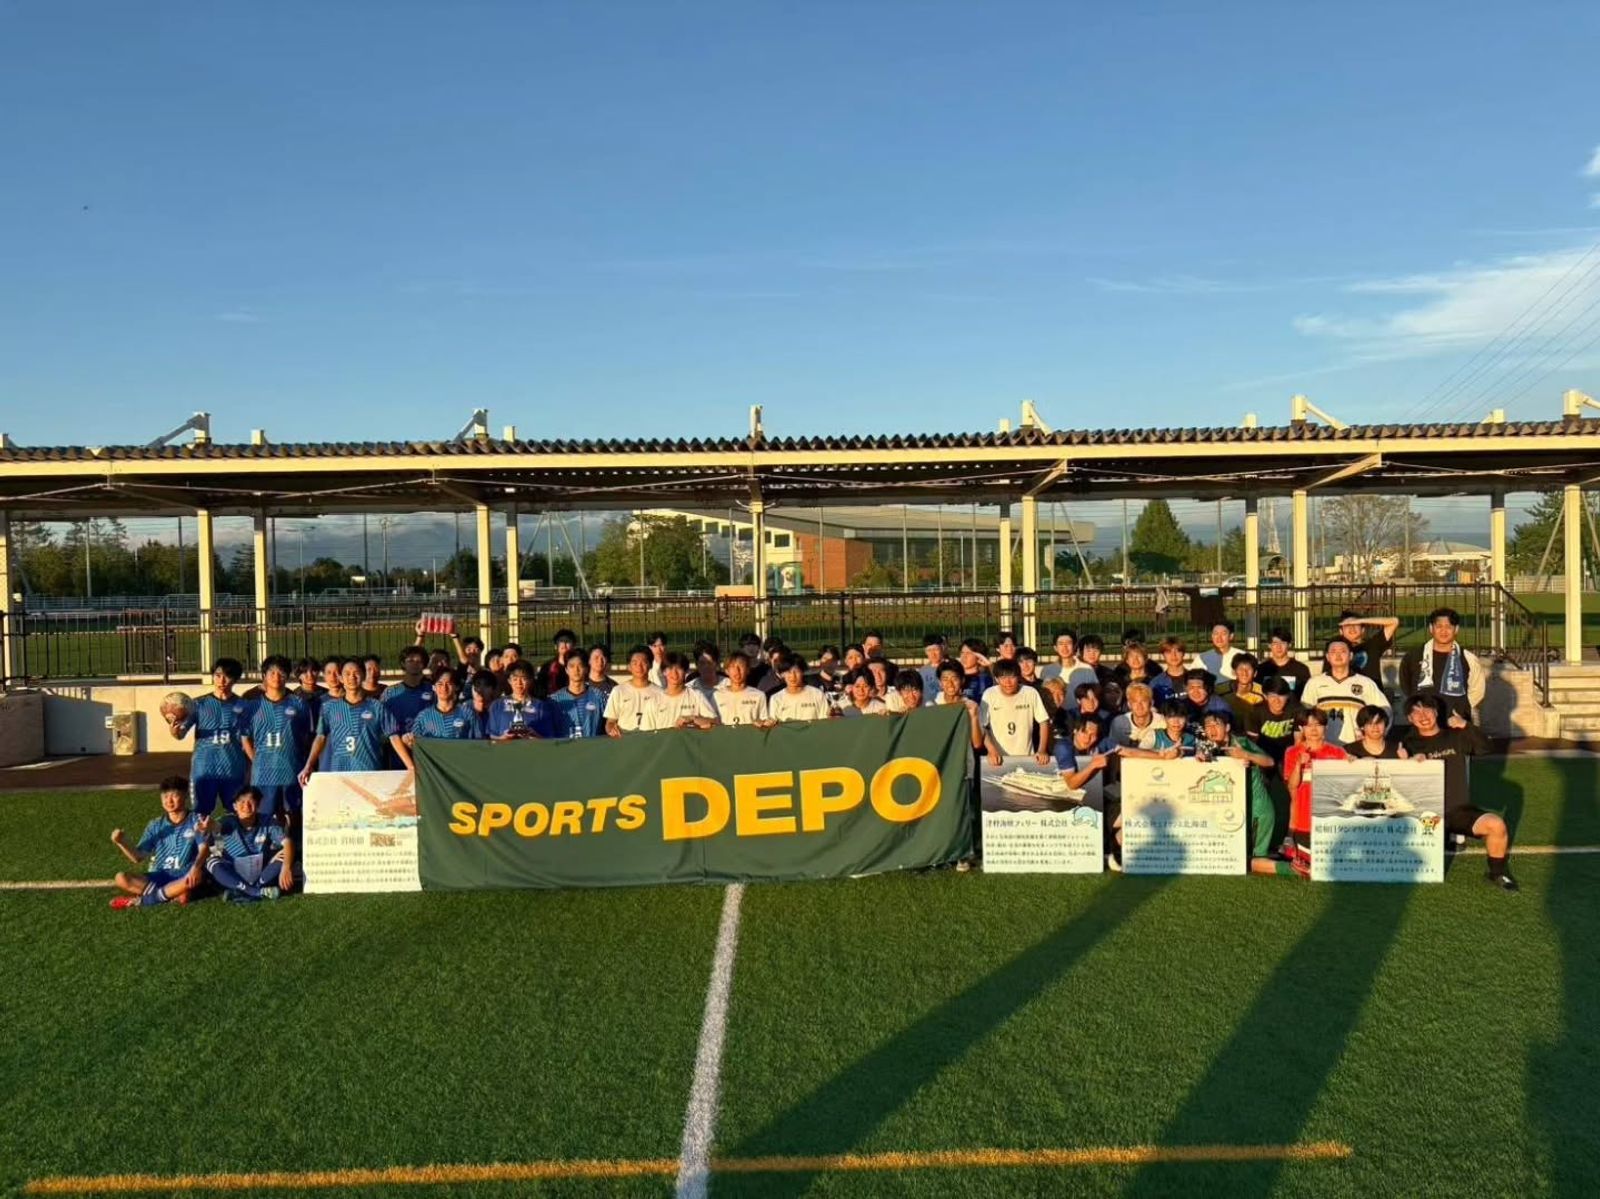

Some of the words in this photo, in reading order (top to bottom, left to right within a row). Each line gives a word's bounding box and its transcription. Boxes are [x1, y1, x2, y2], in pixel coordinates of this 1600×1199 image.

[636, 713, 643, 726] 7
[1008, 722, 1016, 735] 9
[1260, 719, 1294, 738] NIKE
[266, 732, 281, 747] 11
[346, 736, 356, 751] 3
[449, 794, 647, 837] SPORTS
[660, 756, 942, 841] DEPO
[163, 856, 180, 870] 21
